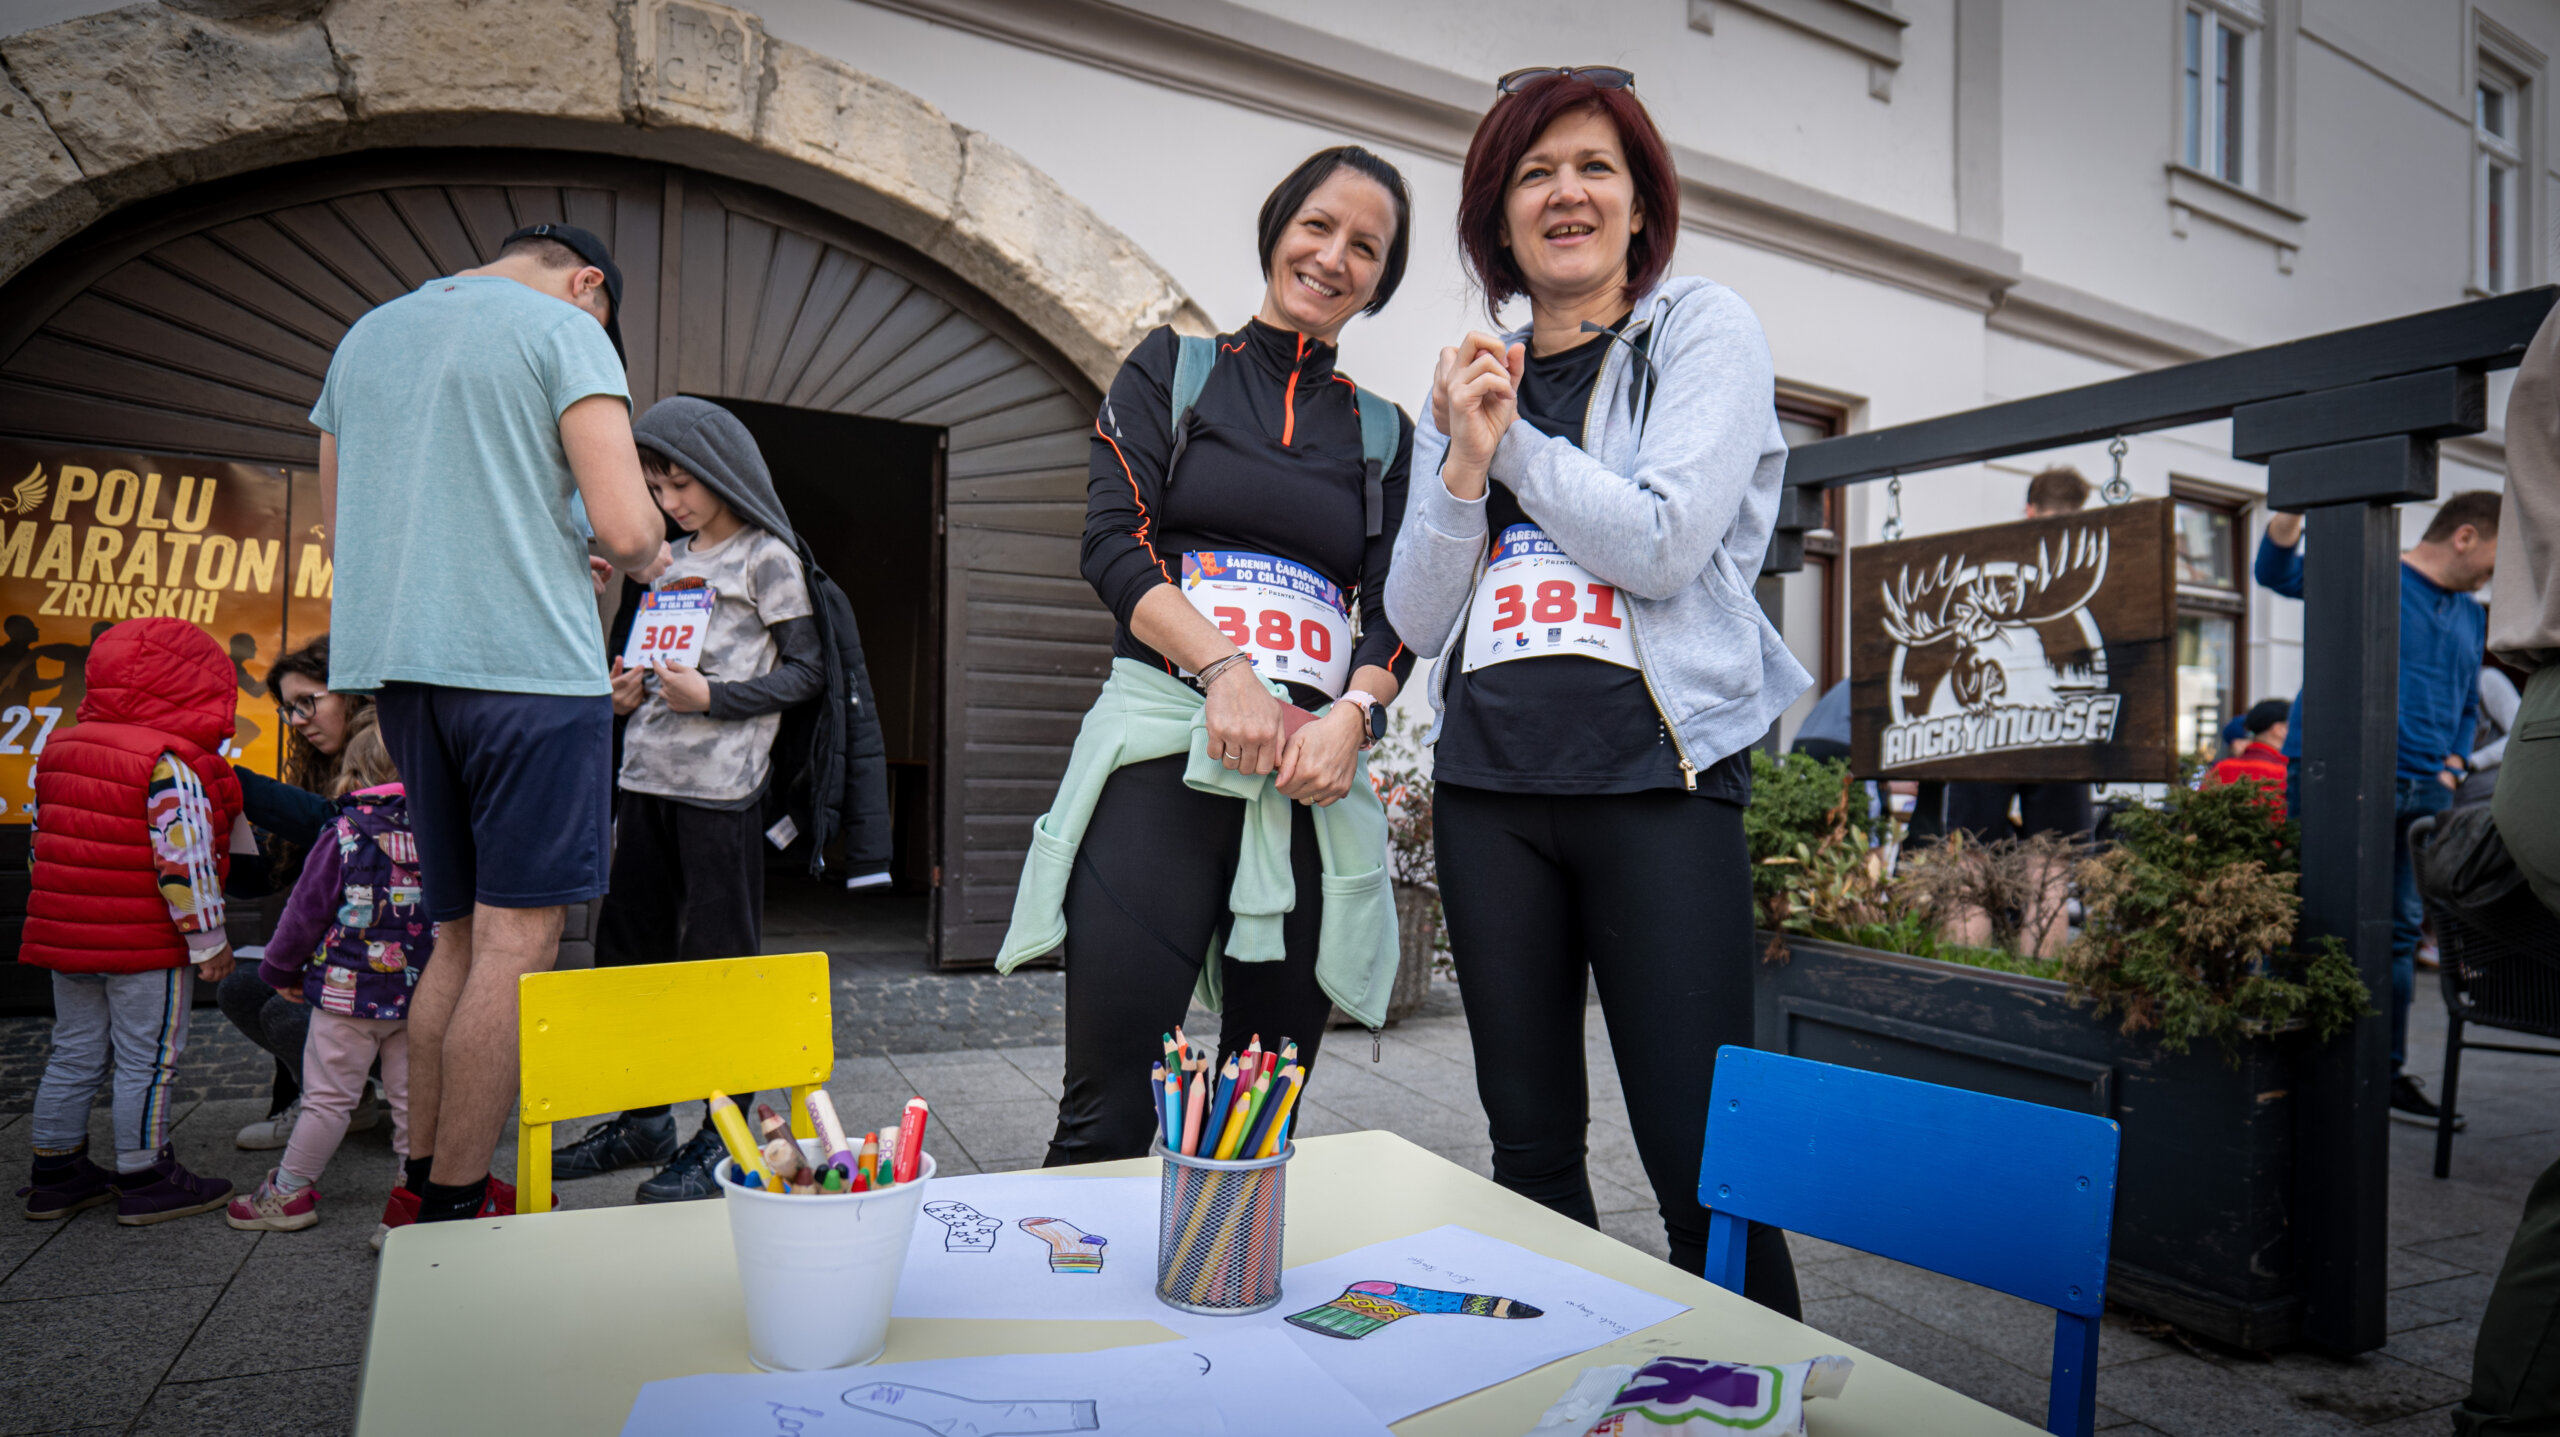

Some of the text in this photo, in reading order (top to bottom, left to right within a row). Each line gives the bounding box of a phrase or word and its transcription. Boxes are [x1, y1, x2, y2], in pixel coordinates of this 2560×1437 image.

[50, 464, 217, 532] POLU
[0, 518, 281, 594] MARATON
[1504, 529, 1550, 545] ŠARENI
[1512, 541, 1530, 555] DO
[1226, 555, 1326, 591] ŠARENIM ČARAPAMA
[1236, 568, 1318, 598] DO CILJA 2025.
[38, 580, 220, 624] ZRINSKIH
[1492, 579, 1622, 632] 381
[640, 624, 695, 651] 302
[1213, 606, 1331, 663] 380
